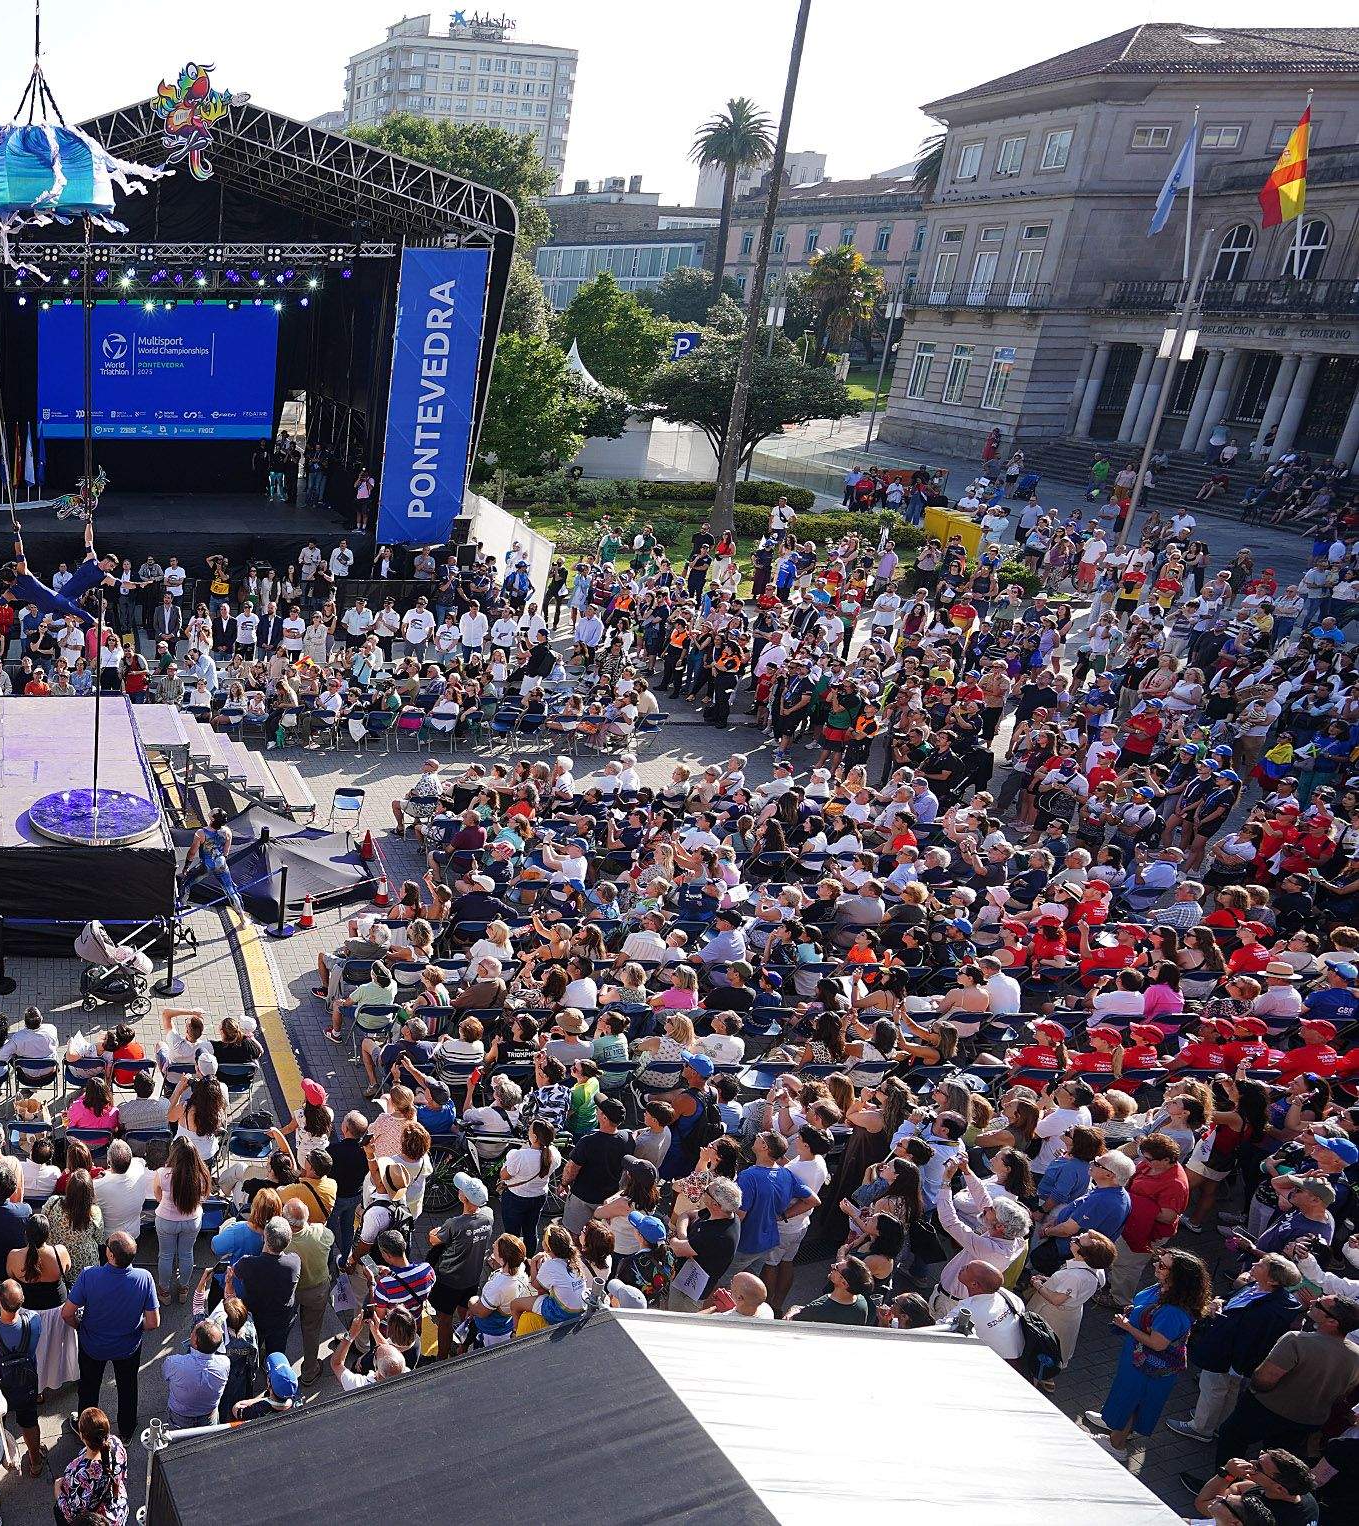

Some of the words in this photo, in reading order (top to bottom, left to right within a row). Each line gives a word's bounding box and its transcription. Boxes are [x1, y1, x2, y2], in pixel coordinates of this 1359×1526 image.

[470, 10, 517, 29] Adeslas
[1199, 325, 1256, 336] DELEGACION
[138, 336, 183, 346] Multisport
[675, 338, 690, 358] P
[159, 347, 210, 355] Championships
[407, 279, 456, 518] PONTEVEDRA
